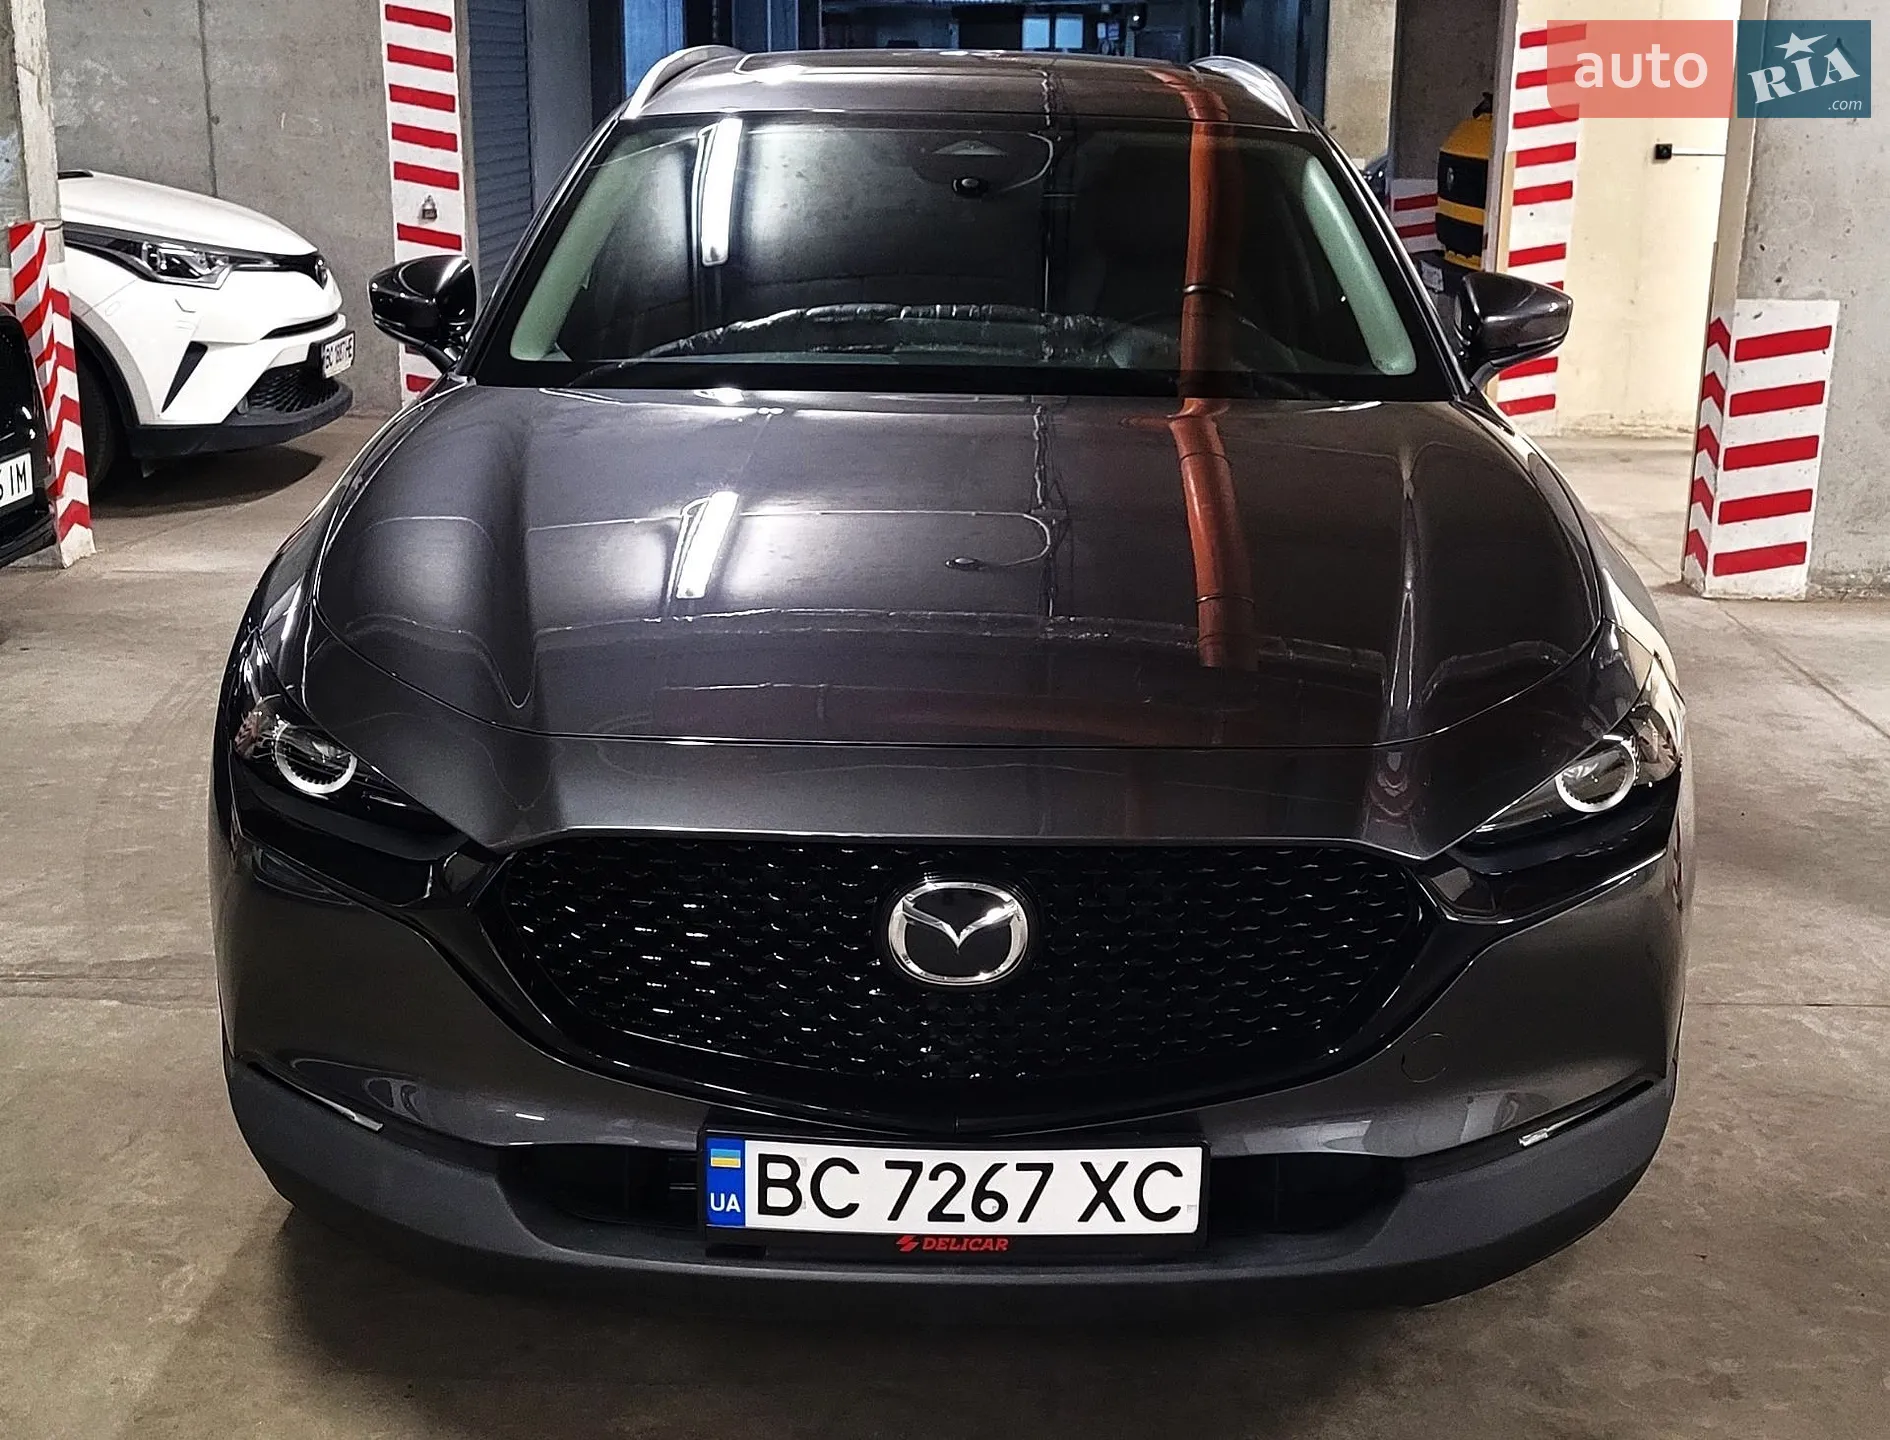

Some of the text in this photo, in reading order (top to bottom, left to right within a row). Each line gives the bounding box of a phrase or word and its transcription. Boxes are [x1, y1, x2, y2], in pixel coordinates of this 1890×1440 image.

[10, 460, 27, 496] IM
[710, 1192, 741, 1213] UA
[758, 1154, 1184, 1223] BC 7267 XC
[922, 1237, 1009, 1251] DELICAR
